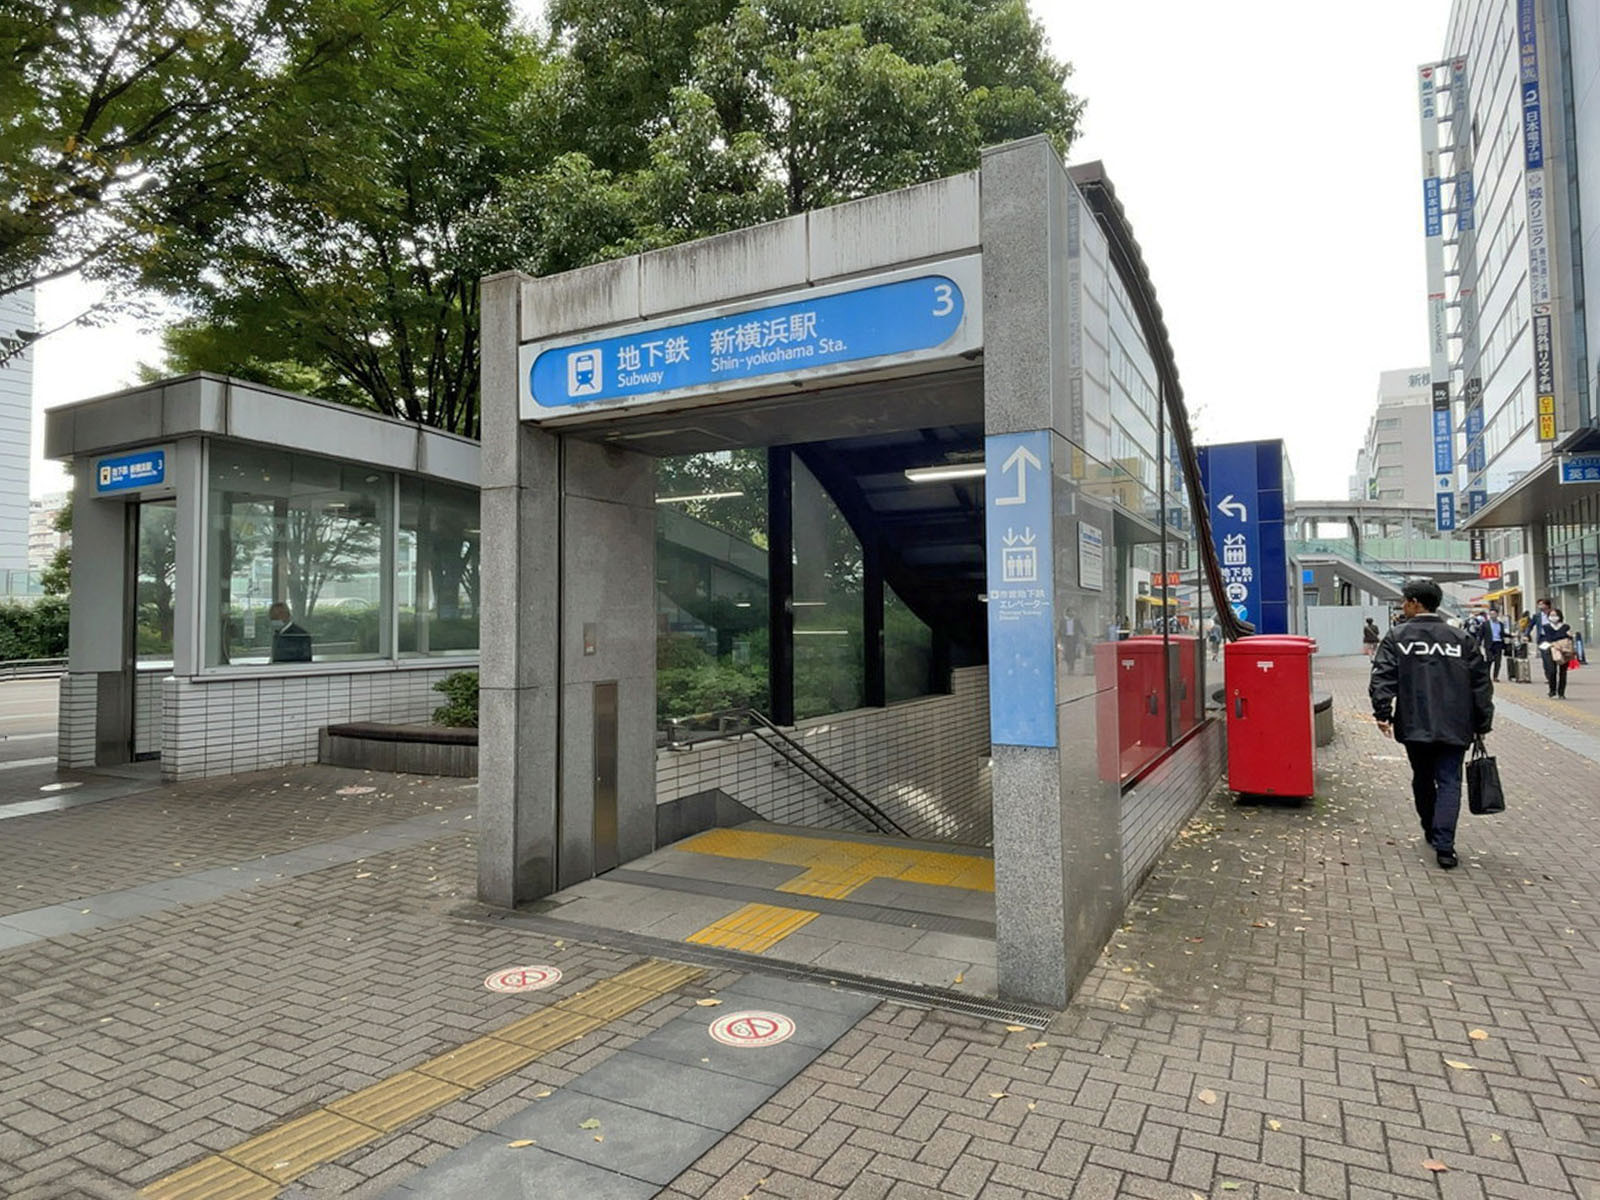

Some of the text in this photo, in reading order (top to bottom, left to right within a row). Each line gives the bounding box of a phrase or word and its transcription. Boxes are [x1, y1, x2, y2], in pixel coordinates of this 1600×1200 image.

[617, 285, 954, 371] 地下鉄 新横浜駅 3
[617, 338, 847, 388] Subway Shin-yokohama Sta.
